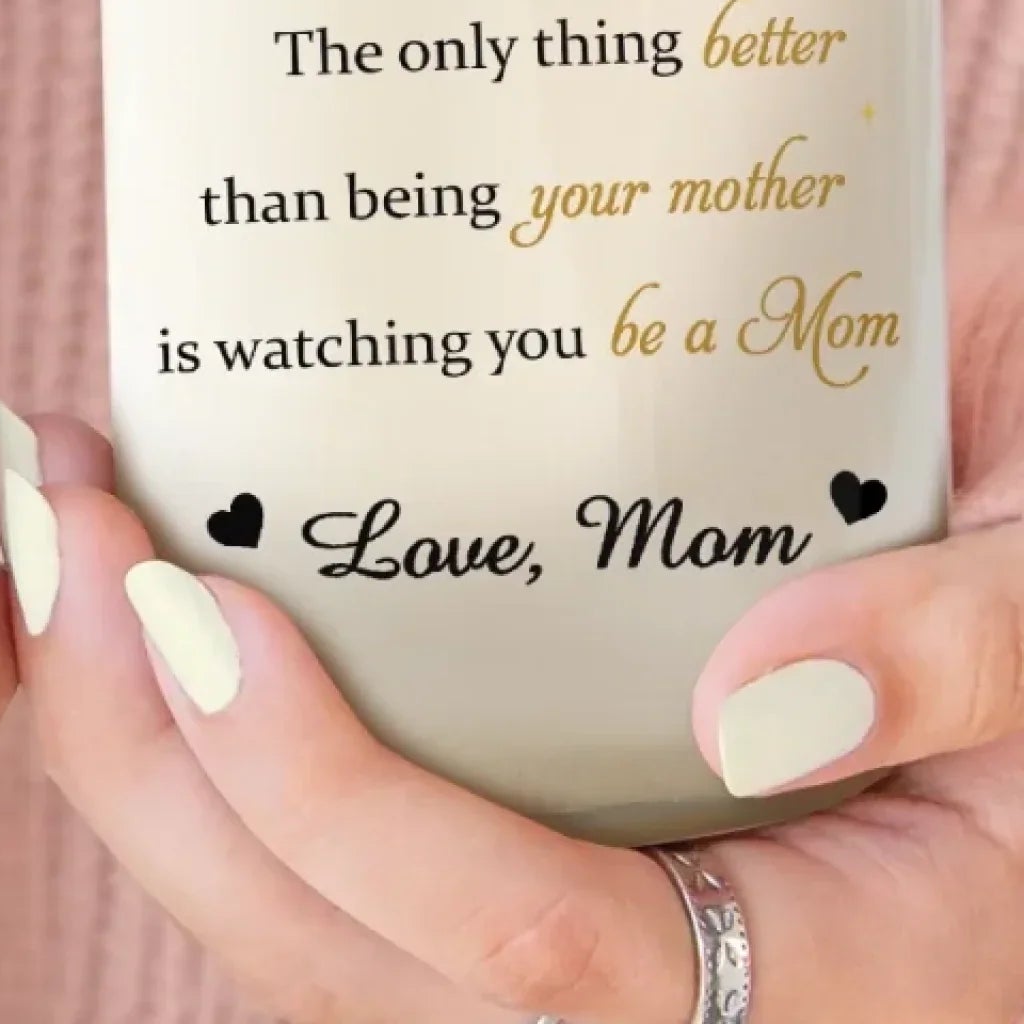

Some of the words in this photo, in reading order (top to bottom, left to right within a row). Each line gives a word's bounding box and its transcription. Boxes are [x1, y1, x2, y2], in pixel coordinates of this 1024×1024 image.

[274, 26, 383, 76] The
[397, 20, 519, 84] only
[533, 18, 684, 78] thing
[199, 176, 329, 227] than
[344, 171, 501, 230] being
[508, 181, 650, 248] your
[668, 134, 846, 214] mother
[158, 328, 201, 374] is
[212, 318, 473, 378] watching
[484, 327, 587, 376] you
[610, 282, 666, 357] be
[683, 319, 718, 355] a
[736, 270, 902, 389] Mom
[300, 497, 543, 586] Love,
[574, 493, 814, 572] Mom
